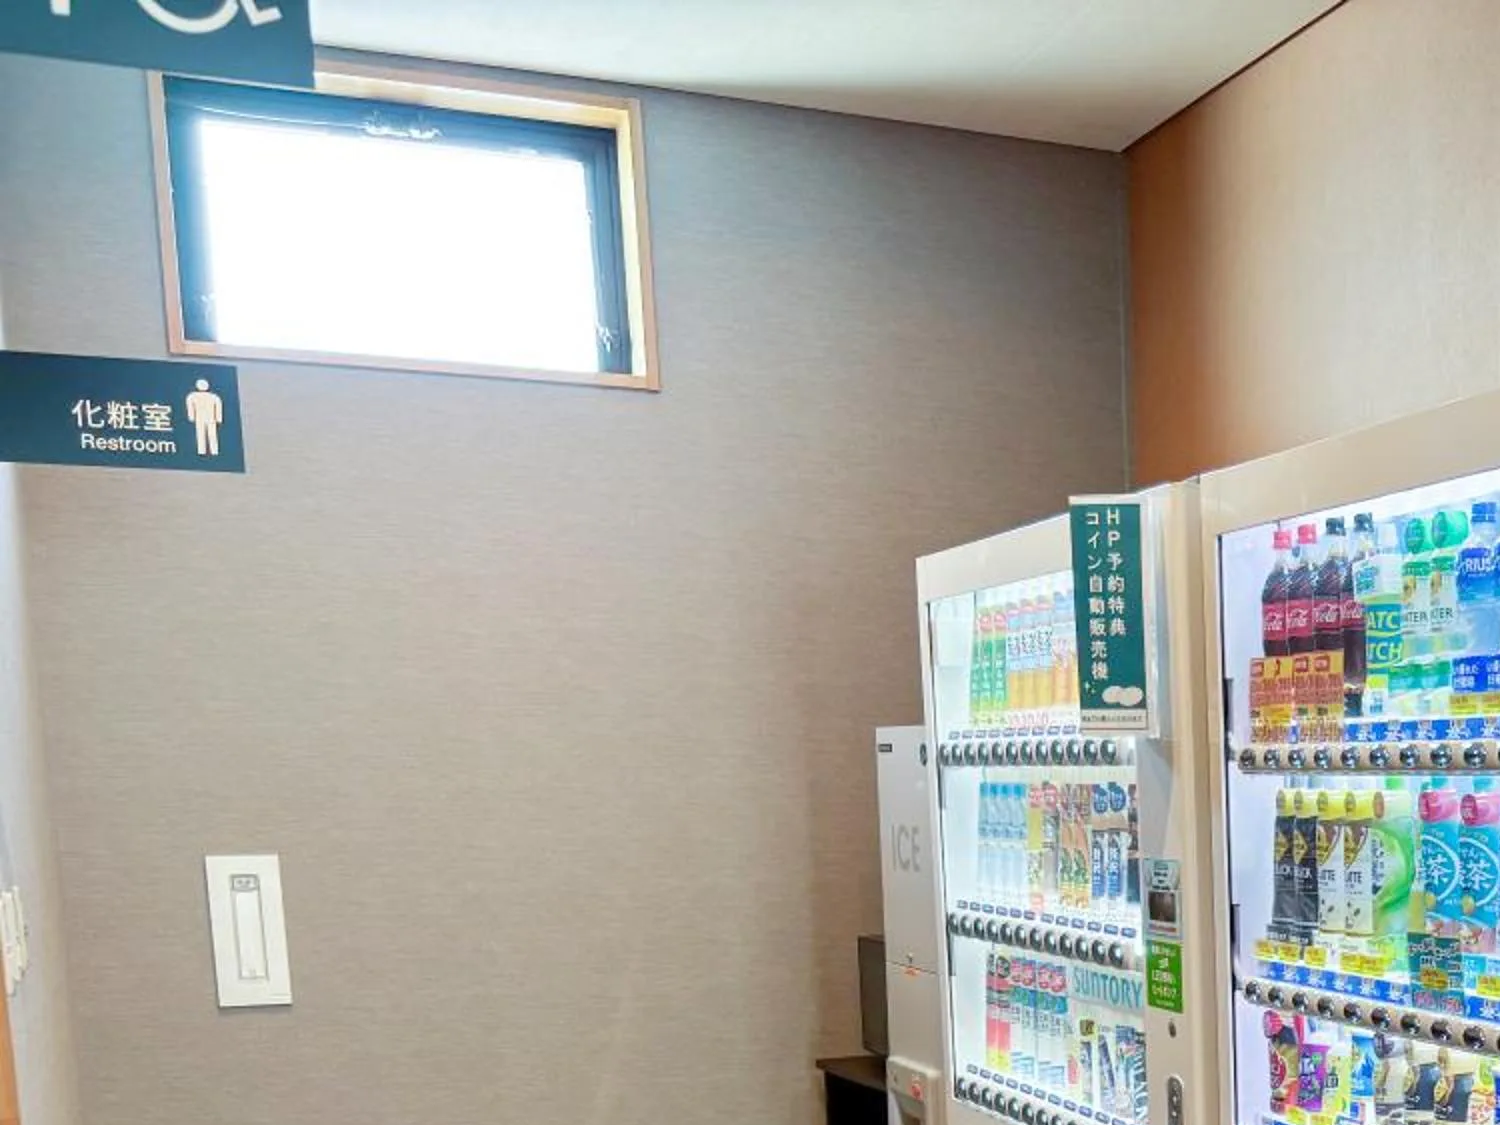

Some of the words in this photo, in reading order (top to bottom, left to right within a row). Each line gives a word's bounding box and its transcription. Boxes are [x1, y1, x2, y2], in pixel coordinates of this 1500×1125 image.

[72, 399, 173, 431] 化粧室
[81, 433, 177, 453] Restroom
[1106, 508, 1127, 637] HP予約特典
[1086, 511, 1109, 681] コイン自動販売機
[891, 823, 921, 873] ICE
[1073, 967, 1143, 1008] SUNTORY
